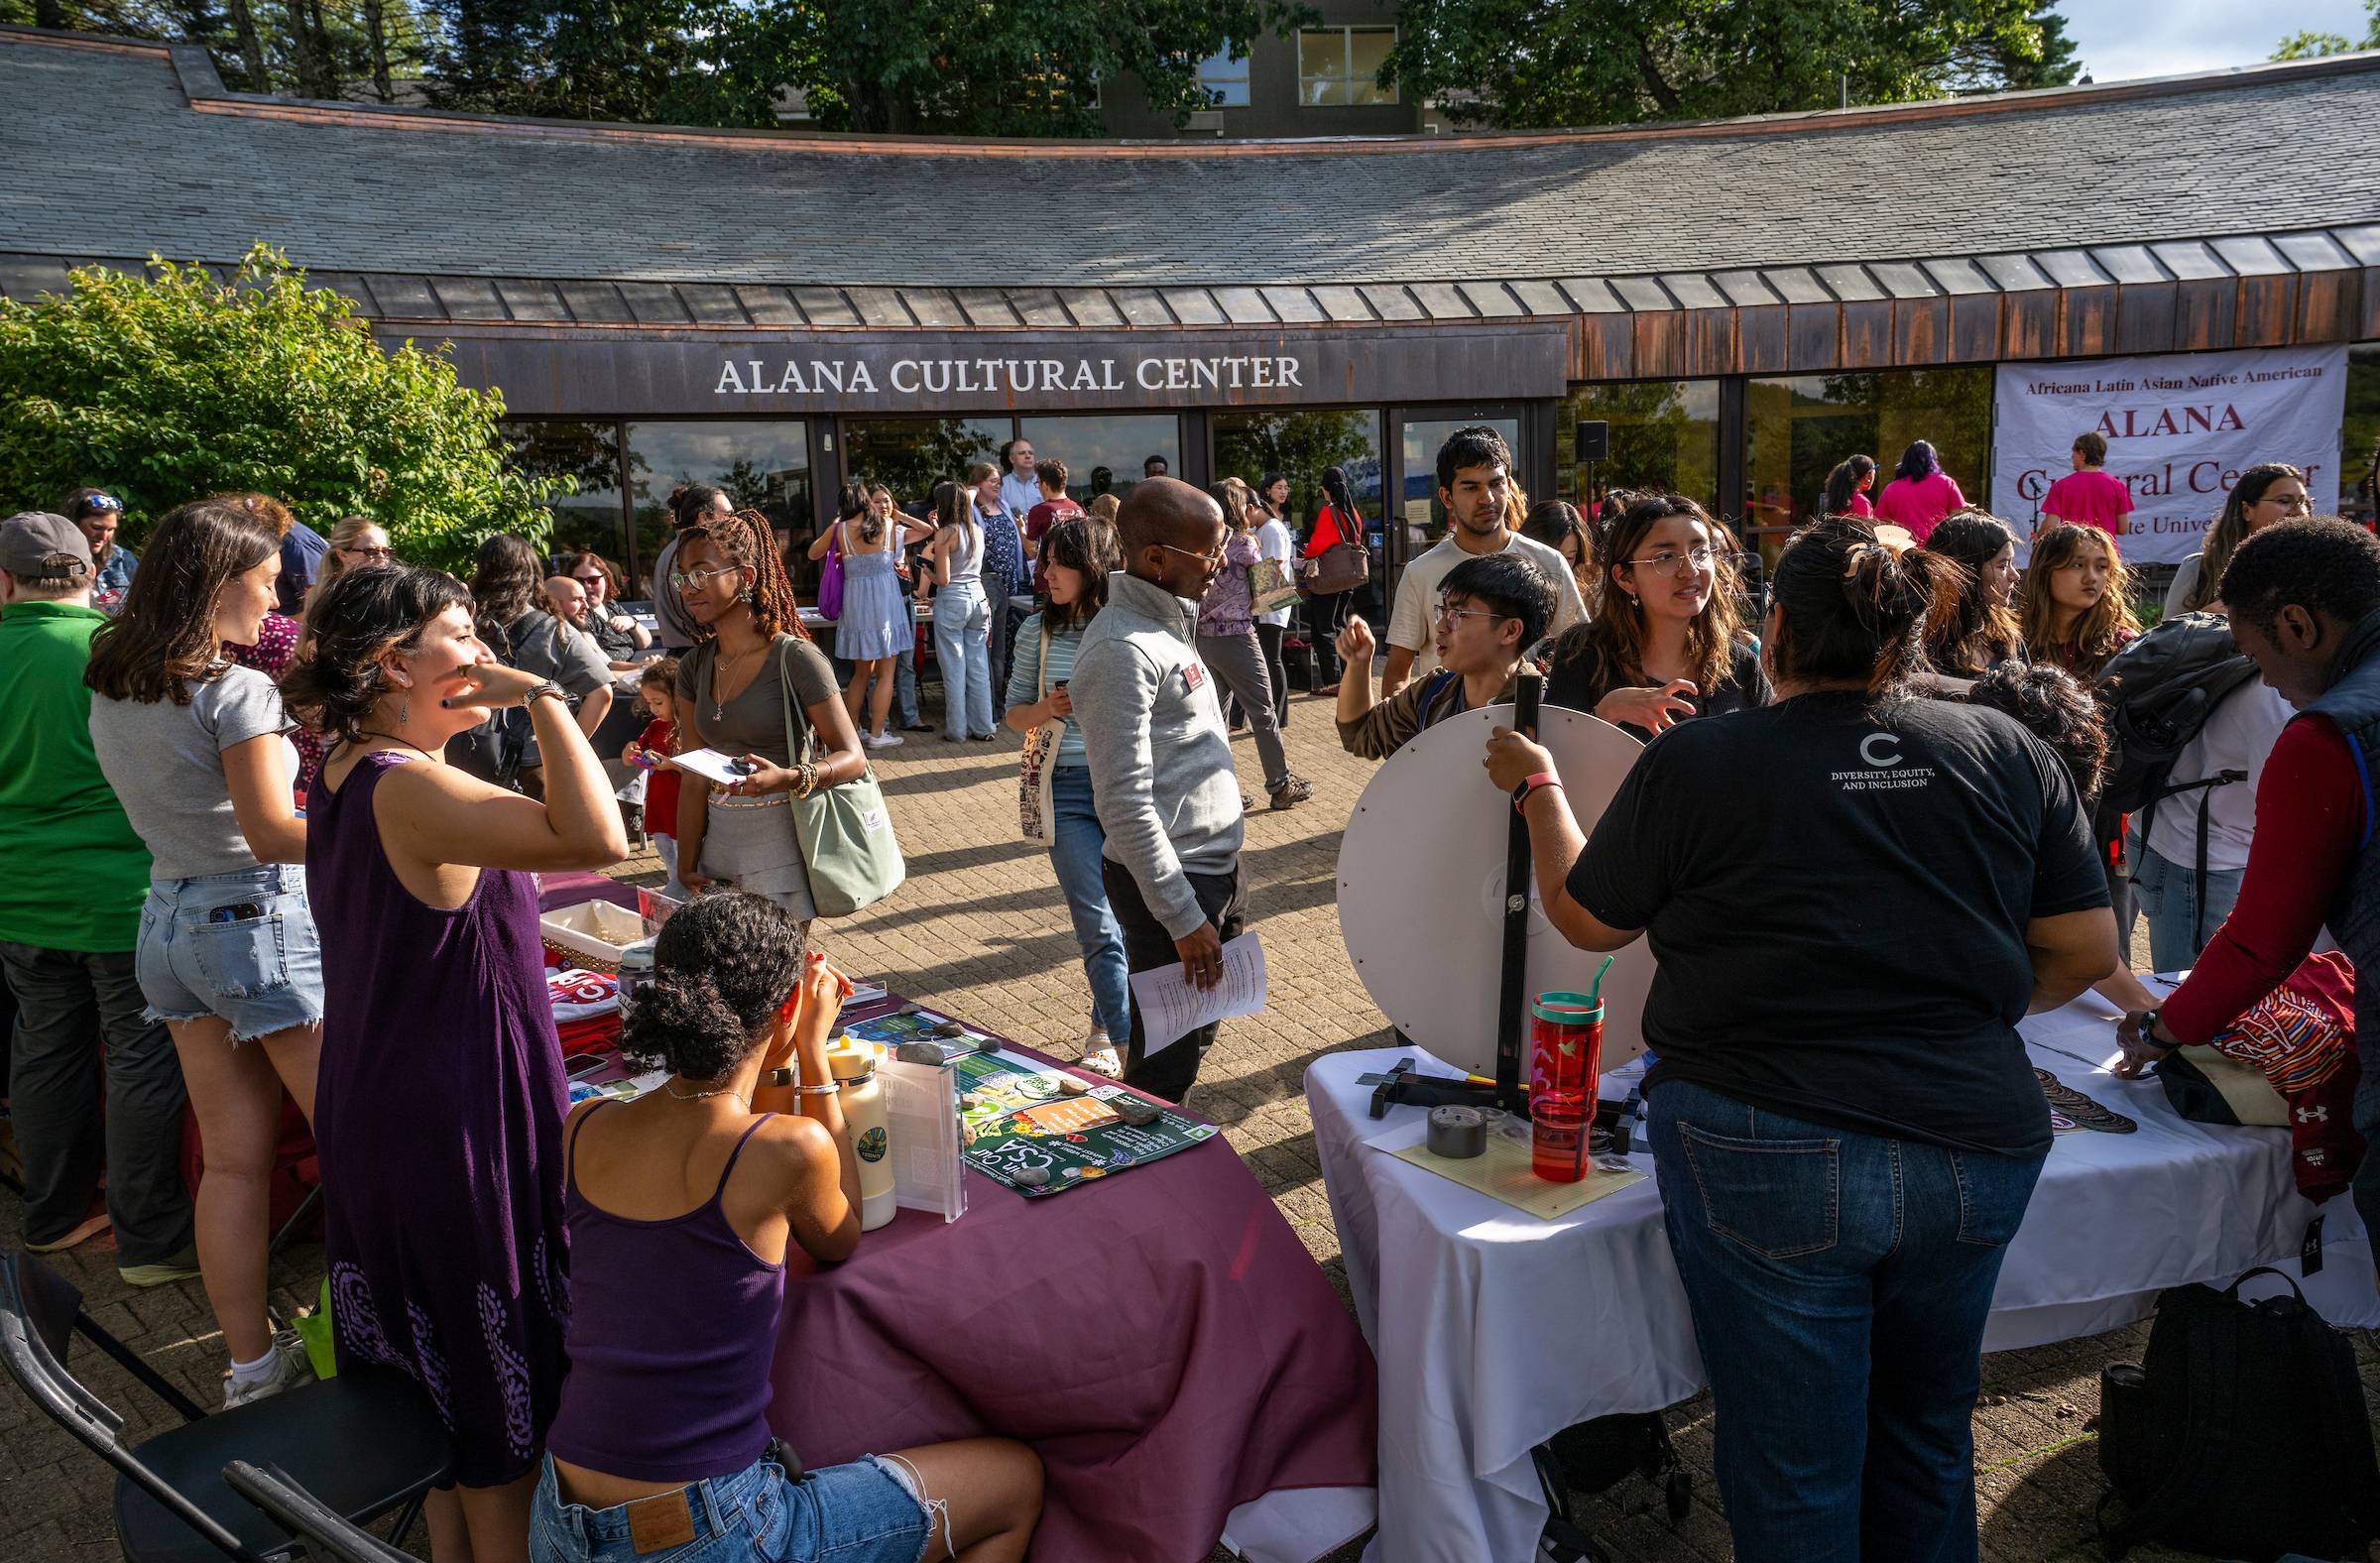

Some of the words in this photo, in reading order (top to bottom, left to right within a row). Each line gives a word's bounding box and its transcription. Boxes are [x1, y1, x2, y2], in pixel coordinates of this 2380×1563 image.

[714, 360, 879, 395] ALANA
[891, 359, 1125, 393] CULTURAL
[1136, 356, 1304, 390] CENTER
[2026, 381, 2090, 396] Africana
[2095, 379, 2135, 393] Latin
[2139, 377, 2183, 390] Asian
[2188, 373, 2238, 388] Native
[2242, 365, 2323, 384] American
[2096, 403, 2245, 438] ALANA
[2017, 462, 2173, 501] Cral
[2189, 461, 2320, 494] Cer
[2154, 517, 2211, 534] Unive
[1859, 733, 1903, 767] C
[1832, 771, 1890, 781] DIVERSITY,
[1892, 768, 1935, 779] EQUITY,
[1868, 779, 1927, 789] INCLUSION
[971, 1148, 1003, 1165] Our
[994, 1140, 1053, 1169] CSA
